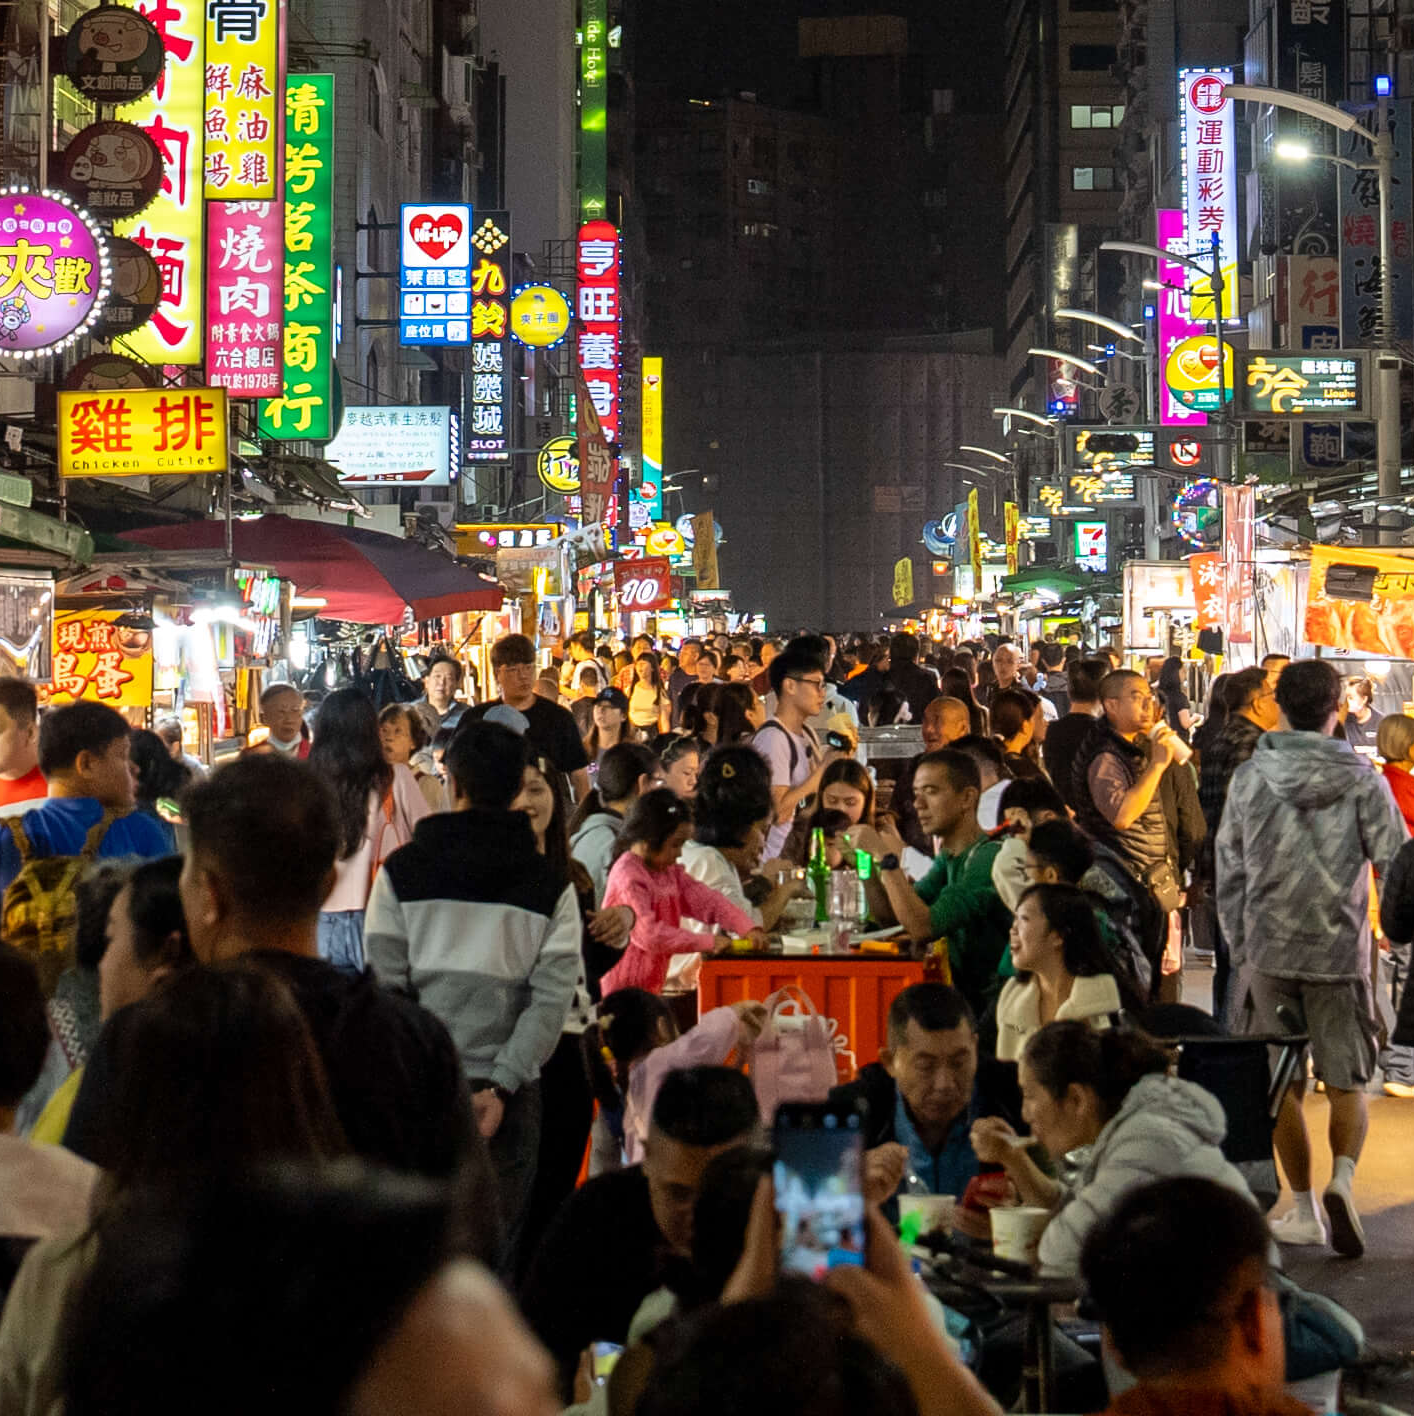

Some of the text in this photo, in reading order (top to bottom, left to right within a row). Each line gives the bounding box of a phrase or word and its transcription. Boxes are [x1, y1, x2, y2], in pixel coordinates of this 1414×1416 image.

[237, 65, 272, 186] 麻油雞
[1196, 120, 1224, 232] 運動彩券
[215, 347, 275, 368] 六合總店
[70, 396, 215, 454] 雞排
